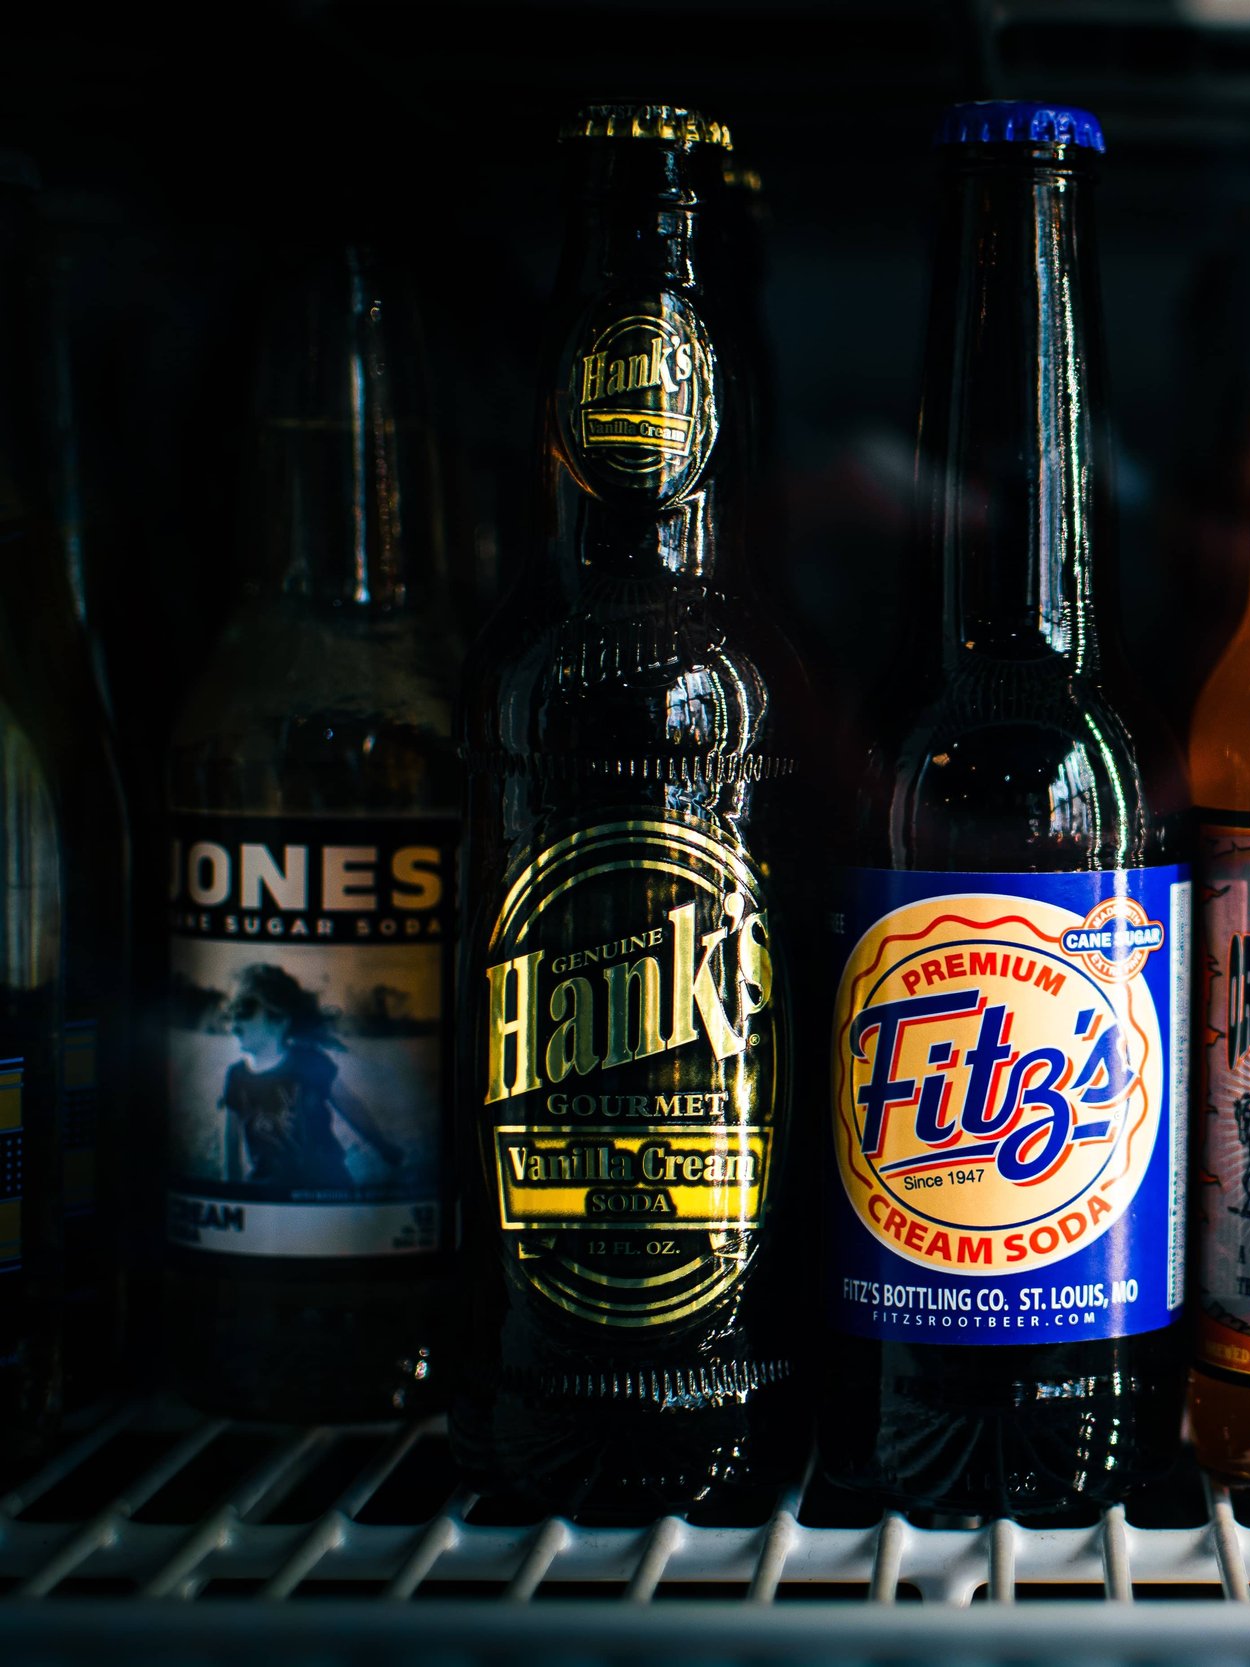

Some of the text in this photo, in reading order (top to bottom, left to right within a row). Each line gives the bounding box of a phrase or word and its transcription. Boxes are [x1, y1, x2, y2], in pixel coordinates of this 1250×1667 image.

[580, 335, 693, 405] Hank's
[588, 419, 686, 443] Vanilla Cream
[224, 914, 335, 937] SUGAR
[355, 917, 443, 937] SODA
[1065, 927, 1161, 949] CANE SUGAR
[552, 927, 663, 974] GENUINE
[901, 952, 1067, 997] PREMIUM
[485, 891, 773, 1105] Hank's
[850, 988, 1140, 1187] Fitz's
[547, 1091, 729, 1118] GOURMET
[507, 1146, 755, 1182] Vanilla Cream
[903, 1169, 985, 1191] Since 1947
[592, 1193, 672, 1213] SODA
[867, 1194, 1113, 1265] CREAM SODA
[587, 1240, 681, 1256] 12 FL. OZ.
[1237, 1245, 1247, 1266] A
[843, 1278, 1138, 1311] FITZ'S BOTTLING CO. ST. LOUIS, MO
[872, 1310, 1096, 1328] FITZSROOTBEER.COM
